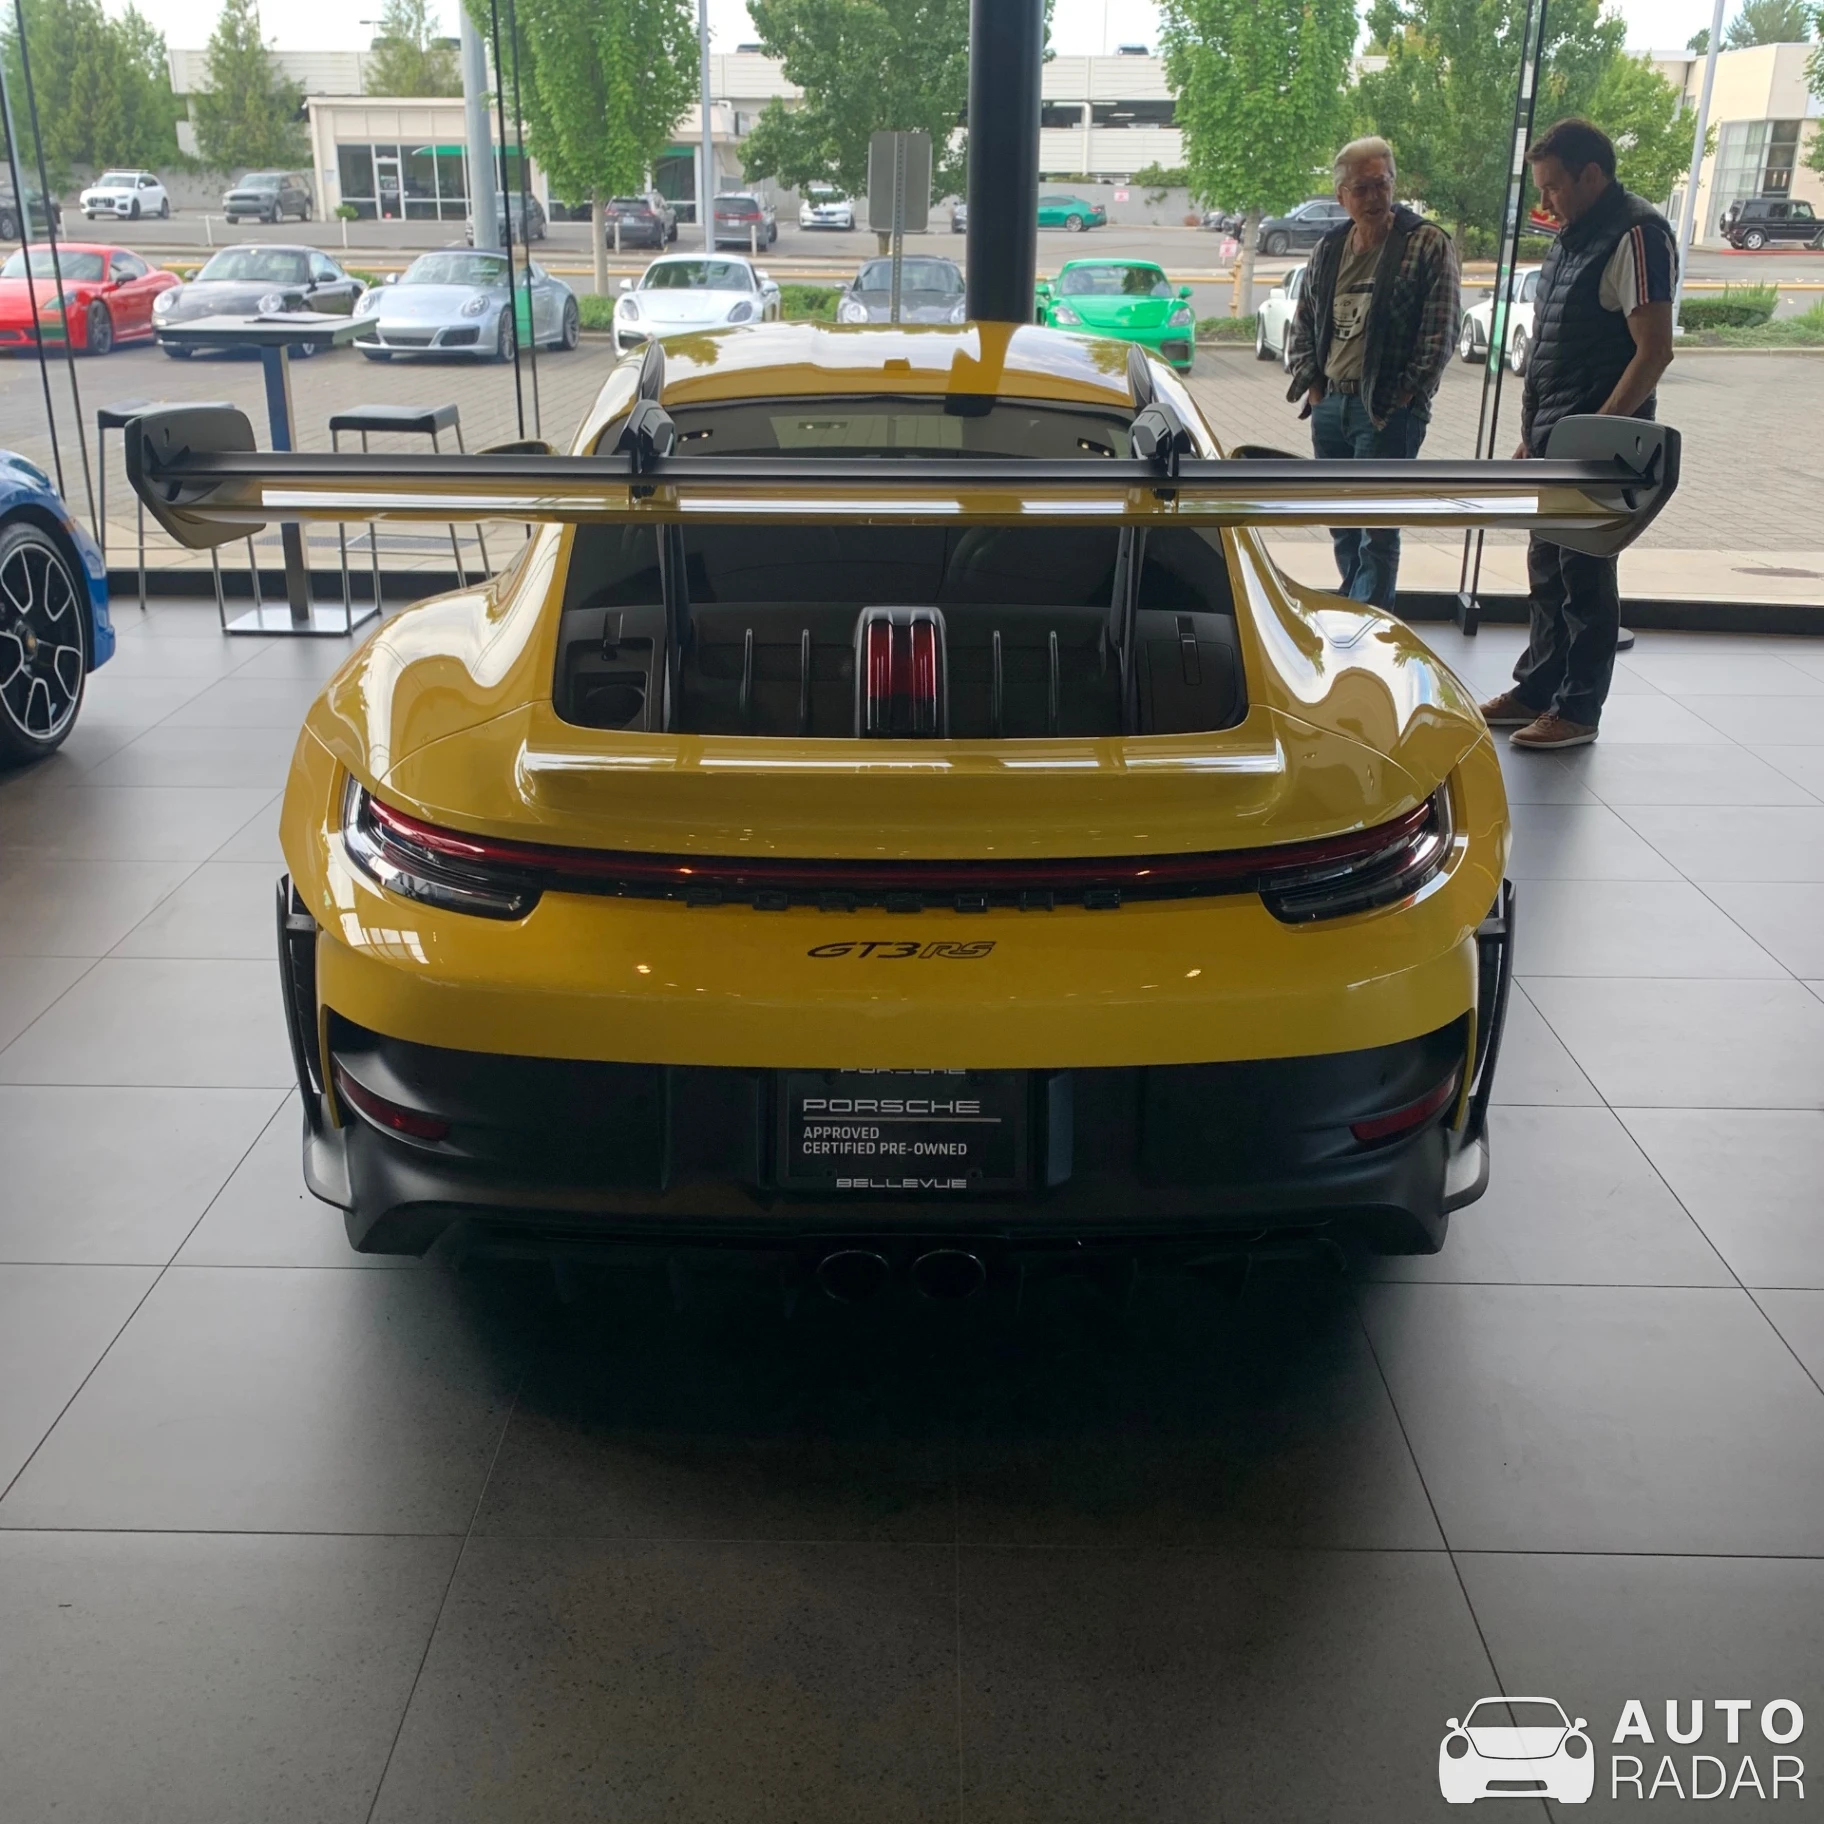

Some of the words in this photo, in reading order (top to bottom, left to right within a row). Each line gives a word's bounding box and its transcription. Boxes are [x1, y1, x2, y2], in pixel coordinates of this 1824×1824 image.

[803, 1098, 981, 1114] PORSCHE
[803, 1126, 880, 1139] APPROVED
[802, 1142, 876, 1155] CERTIFIED
[879, 1142, 968, 1155] PRE-OWNED
[836, 1178, 967, 1189] BELLEVUE
